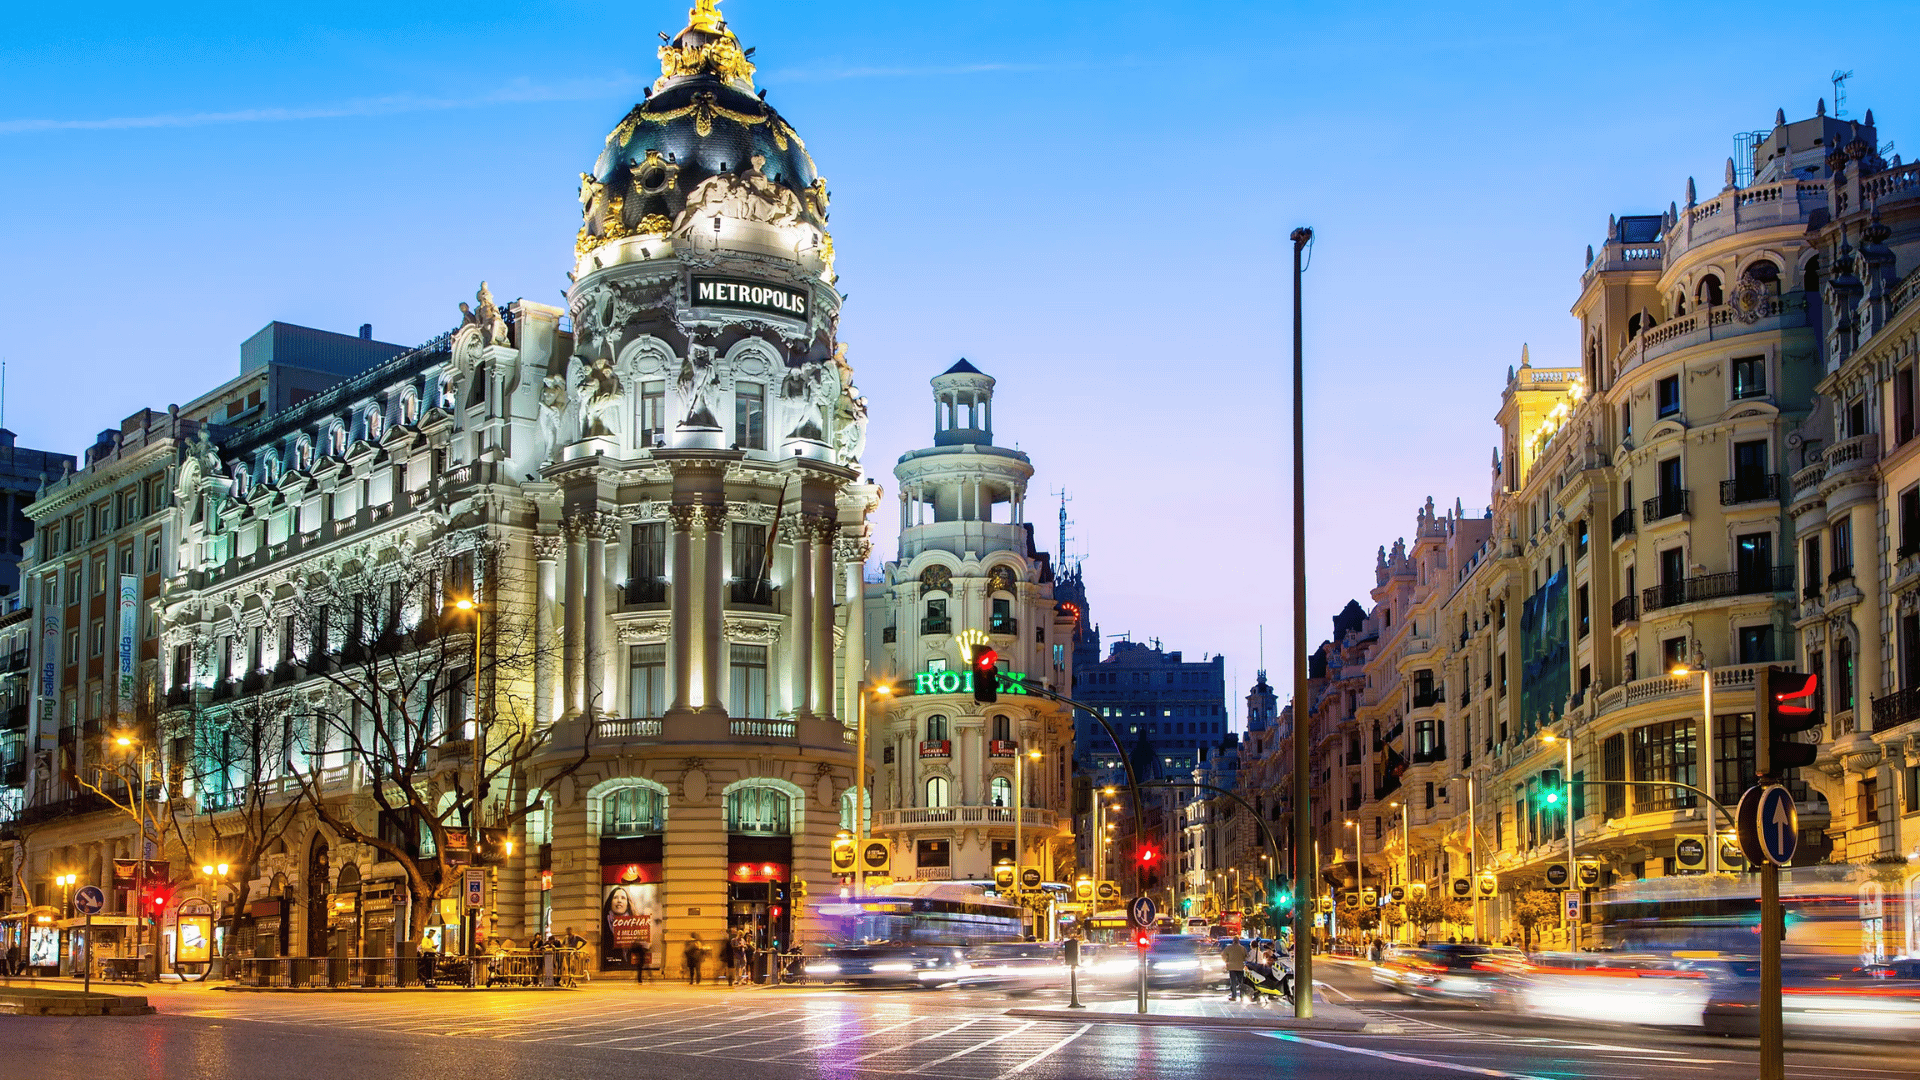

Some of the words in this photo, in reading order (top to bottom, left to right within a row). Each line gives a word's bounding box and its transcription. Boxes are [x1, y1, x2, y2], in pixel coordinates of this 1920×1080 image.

[699, 282, 805, 314] METROPOLIS
[120, 636, 131, 672] salida
[43, 662, 55, 697] salida
[120, 675, 133, 698] hay
[42, 699, 56, 721] hay
[613, 918, 652, 926] CONFIAR
